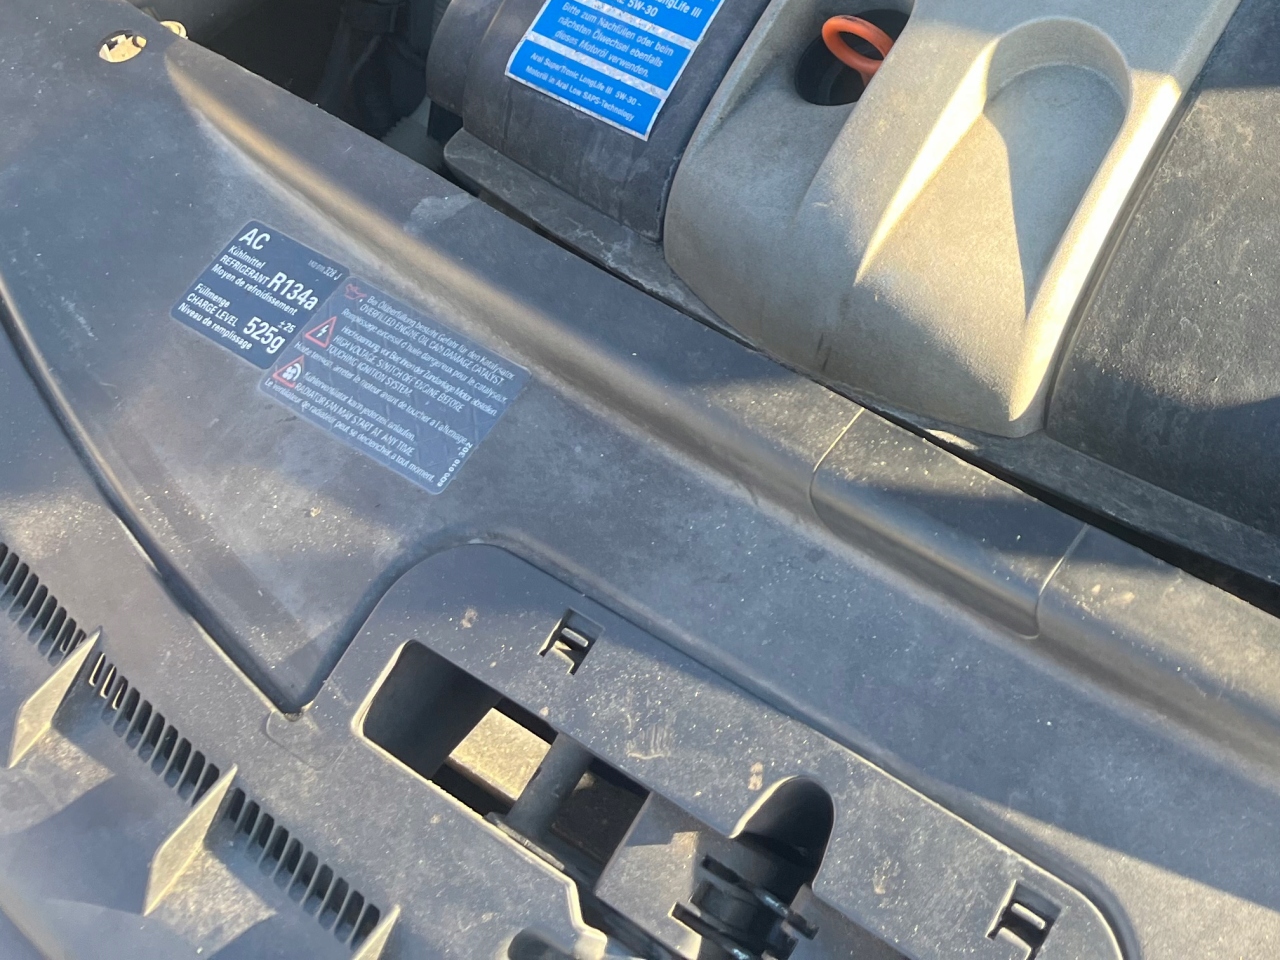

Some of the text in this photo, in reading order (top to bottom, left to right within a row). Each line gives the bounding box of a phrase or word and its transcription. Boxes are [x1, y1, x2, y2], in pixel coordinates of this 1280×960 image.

[562, 1, 673, 55] Bitte zum Nachfüllen oder beim
[691, 7, 701, 17] III
[554, 29, 650, 76] dieses Motoröl verwenden.
[558, 16, 663, 66] nächsten Ölwechsel ebenfalls
[525, 65, 548, 80] Motoröl
[555, 80, 568, 89] Aral
[569, 86, 581, 95] Low
[580, 91, 635, 121] SAPS-Technology
[530, 53, 543, 62] Aral
[543, 58, 578, 79] SuperTronic
[578, 74, 604, 91] LongLife
[605, 85, 613, 93] III
[615, 91, 636, 104] 5W-30
[228, 244, 266, 268] Kühlmittel
[239, 228, 270, 250] AC
[195, 283, 230, 308] Füllmenge
[212, 264, 298, 316] Moyen de refroidissement
[220, 254, 269, 284] REFRIGERANT
[267, 272, 319, 311] R134a
[178, 302, 252, 350] Niveau de remplissage
[186, 292, 286, 354] CHARGE LEVEL 525g
[359, 303, 396, 326] OVERFILLED
[394, 322, 419, 339] ENGINE
[417, 334, 429, 345] OIL
[428, 341, 444, 352] CAN
[442, 348, 472, 368] DAMAGE
[325, 344, 358, 365] TOUCHING
[356, 361, 386, 381] IGNITION
[333, 335, 350, 347] HIGH
[376, 359, 403, 377] SWITCH
[401, 373, 415, 384] OFF
[413, 380, 439, 397] ENGINE
[437, 393, 464, 412] BEFORE
[451, 370, 467, 382] pour
[467, 377, 475, 385] le
[467, 350, 481, 360] den
[294, 382, 326, 404] RADIATOR
[323, 399, 338, 411] FAN
[336, 406, 353, 420] MAY
[350, 415, 373, 431] START
[371, 427, 381, 436] AT
[381, 433, 397, 446] ANY
[359, 379, 381, 394] moteur
[397, 400, 407, 409] de
[264, 378, 273, 386] Le
[333, 420, 349, 433] peut
[348, 428, 357, 436] se
[395, 455, 409, 466] tout
[448, 459, 460, 472] 010
[458, 442, 473, 458] 302
